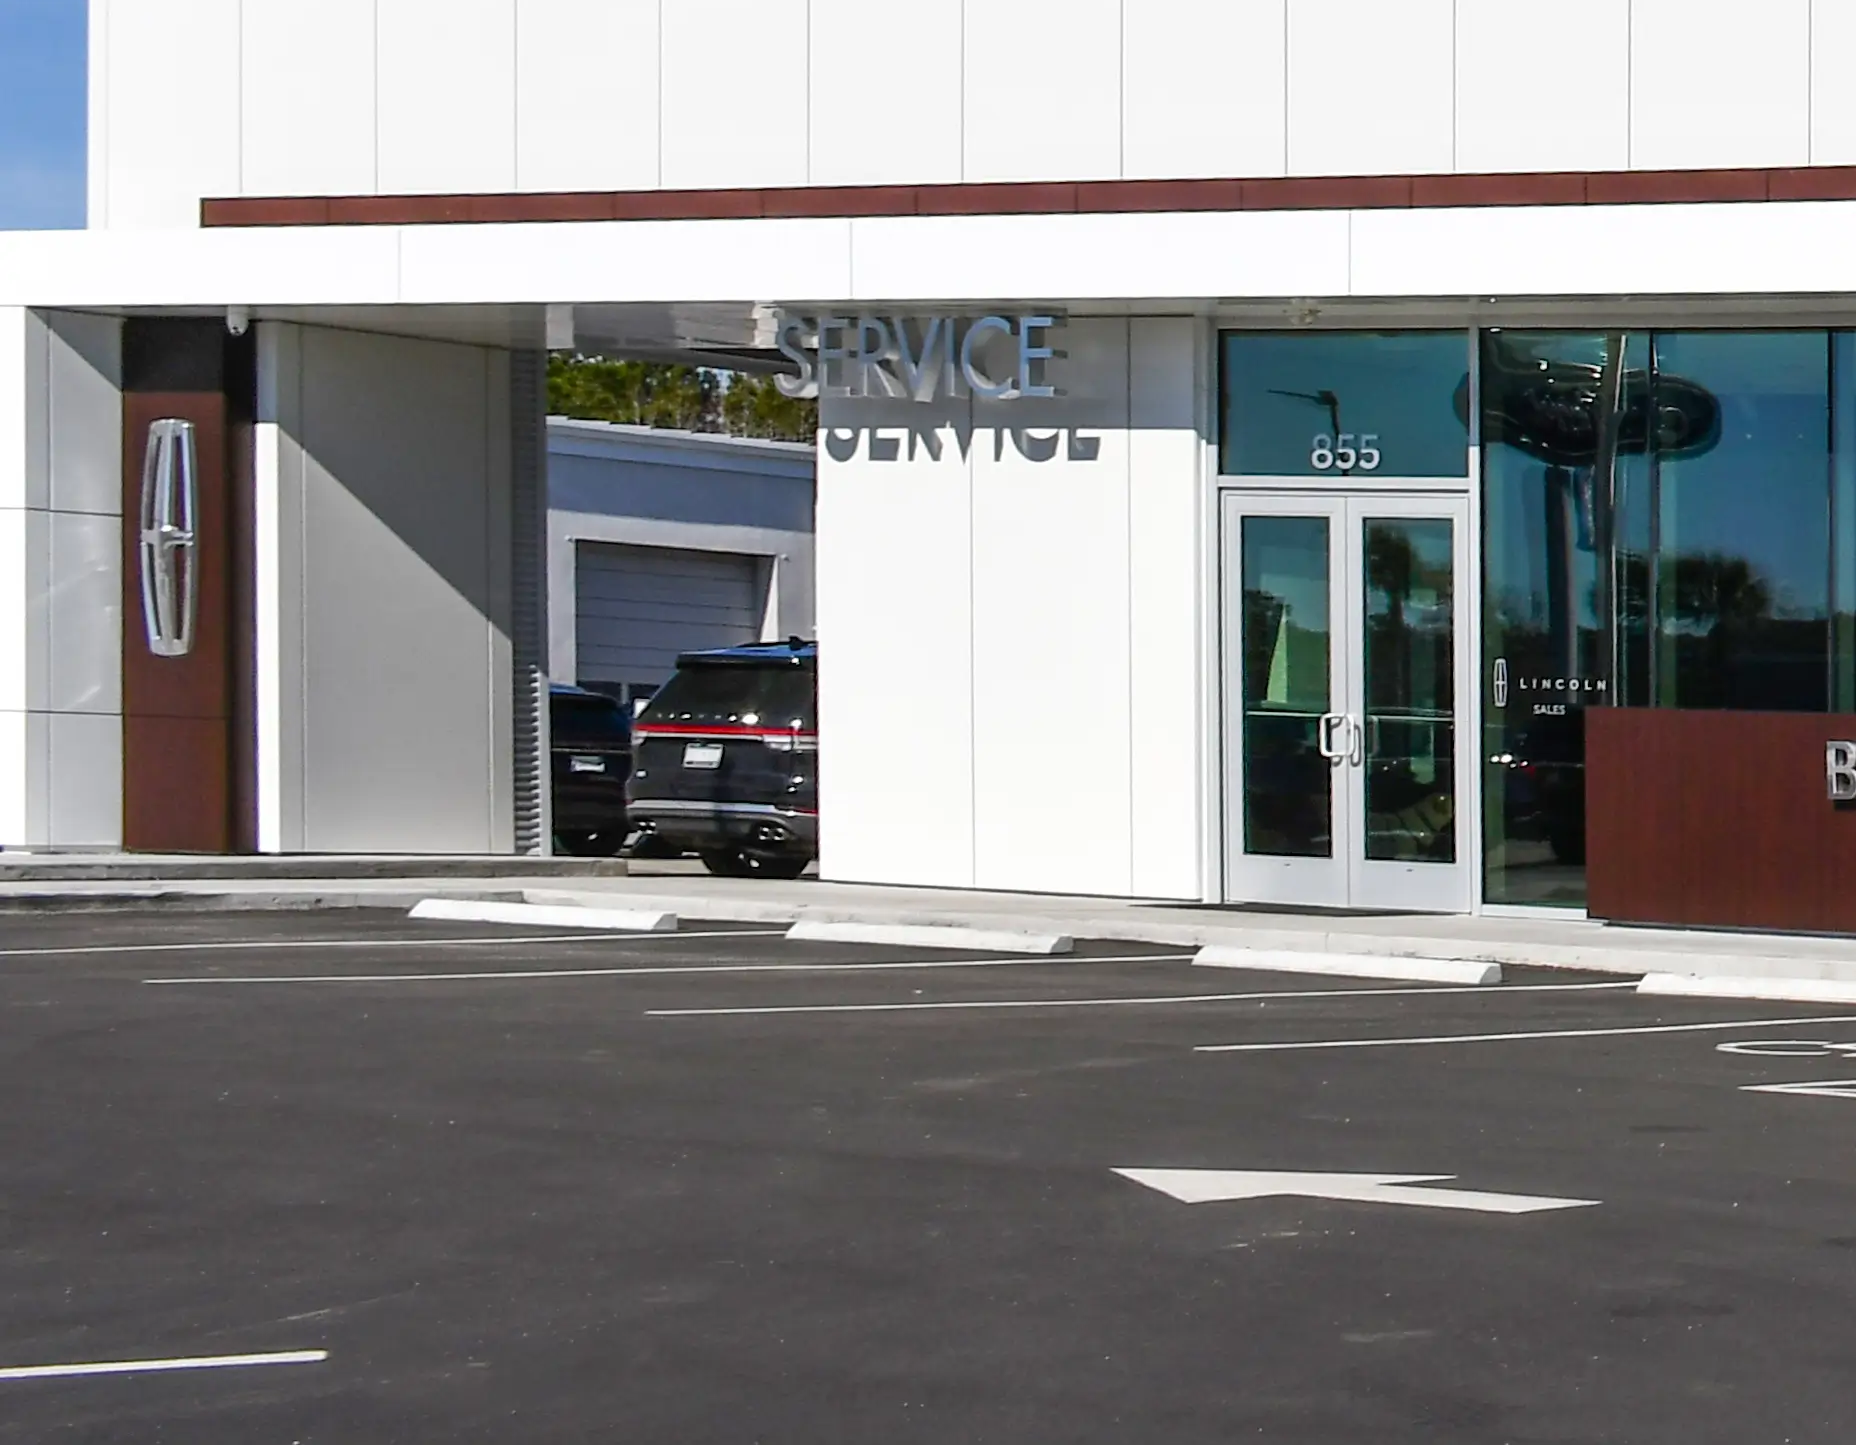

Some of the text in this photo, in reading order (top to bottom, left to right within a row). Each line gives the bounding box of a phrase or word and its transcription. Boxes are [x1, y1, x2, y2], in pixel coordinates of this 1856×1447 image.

[773, 313, 1057, 402] SERVICE
[1311, 433, 1380, 470] 855
[1519, 677, 1607, 691] LINCOLN
[1533, 704, 1566, 715] SALES
